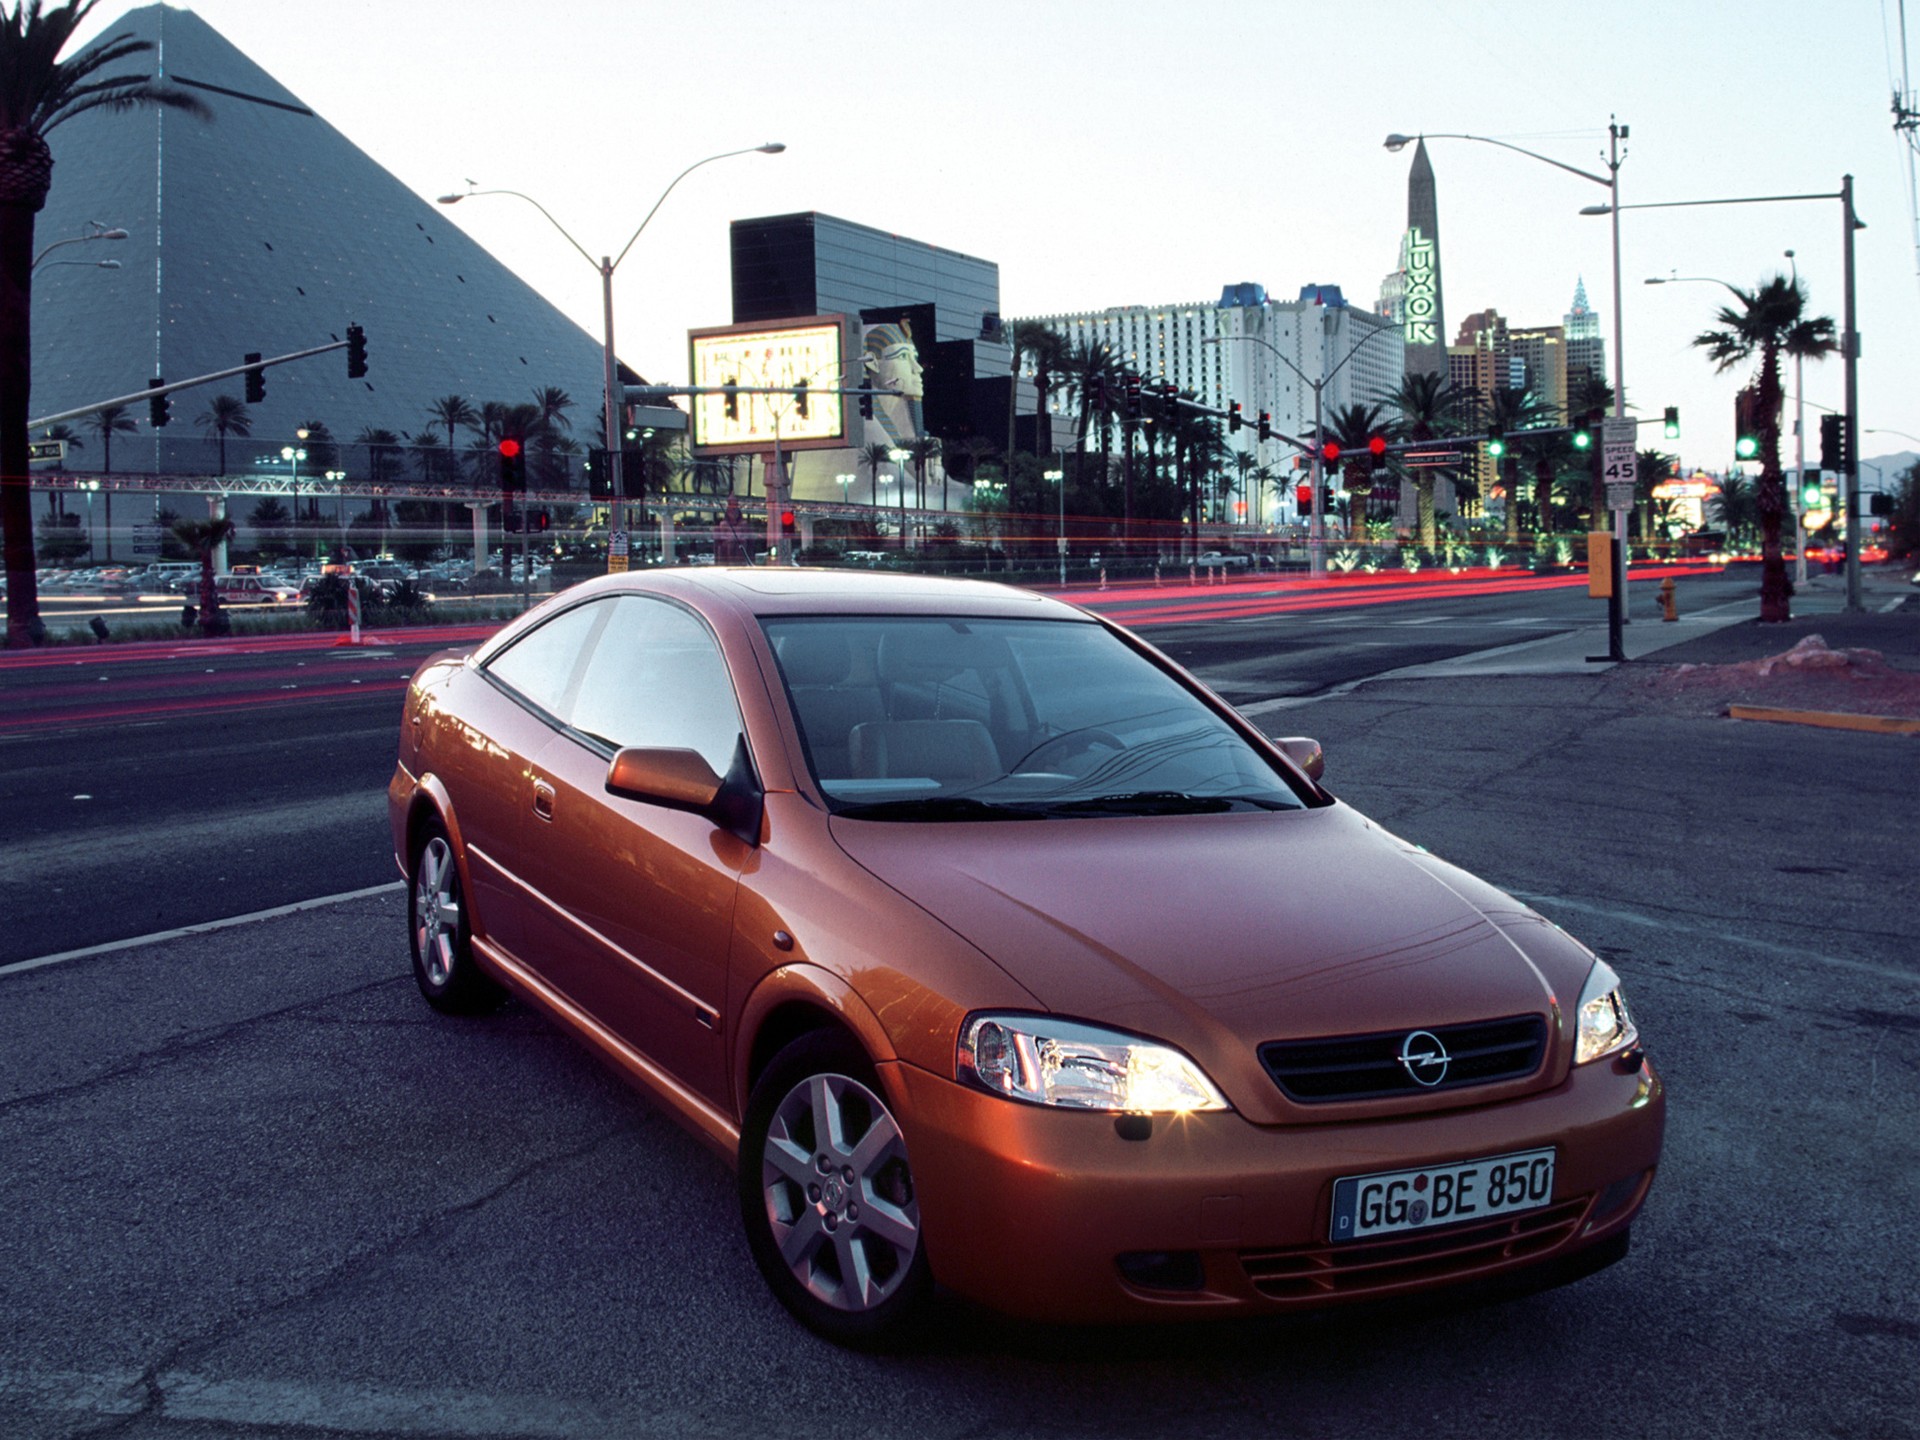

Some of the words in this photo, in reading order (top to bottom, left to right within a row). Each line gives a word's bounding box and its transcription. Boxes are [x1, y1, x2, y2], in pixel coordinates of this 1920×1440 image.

[1407, 228, 1435, 342] LUXOR
[1605, 446, 1634, 454] SPEED
[1608, 454, 1631, 462] LIMIT
[1605, 463, 1634, 478] 45
[1359, 1180, 1409, 1229] GG
[1431, 1169, 1478, 1219] BE
[1487, 1157, 1549, 1208] 850
[1340, 1216, 1349, 1229] D
